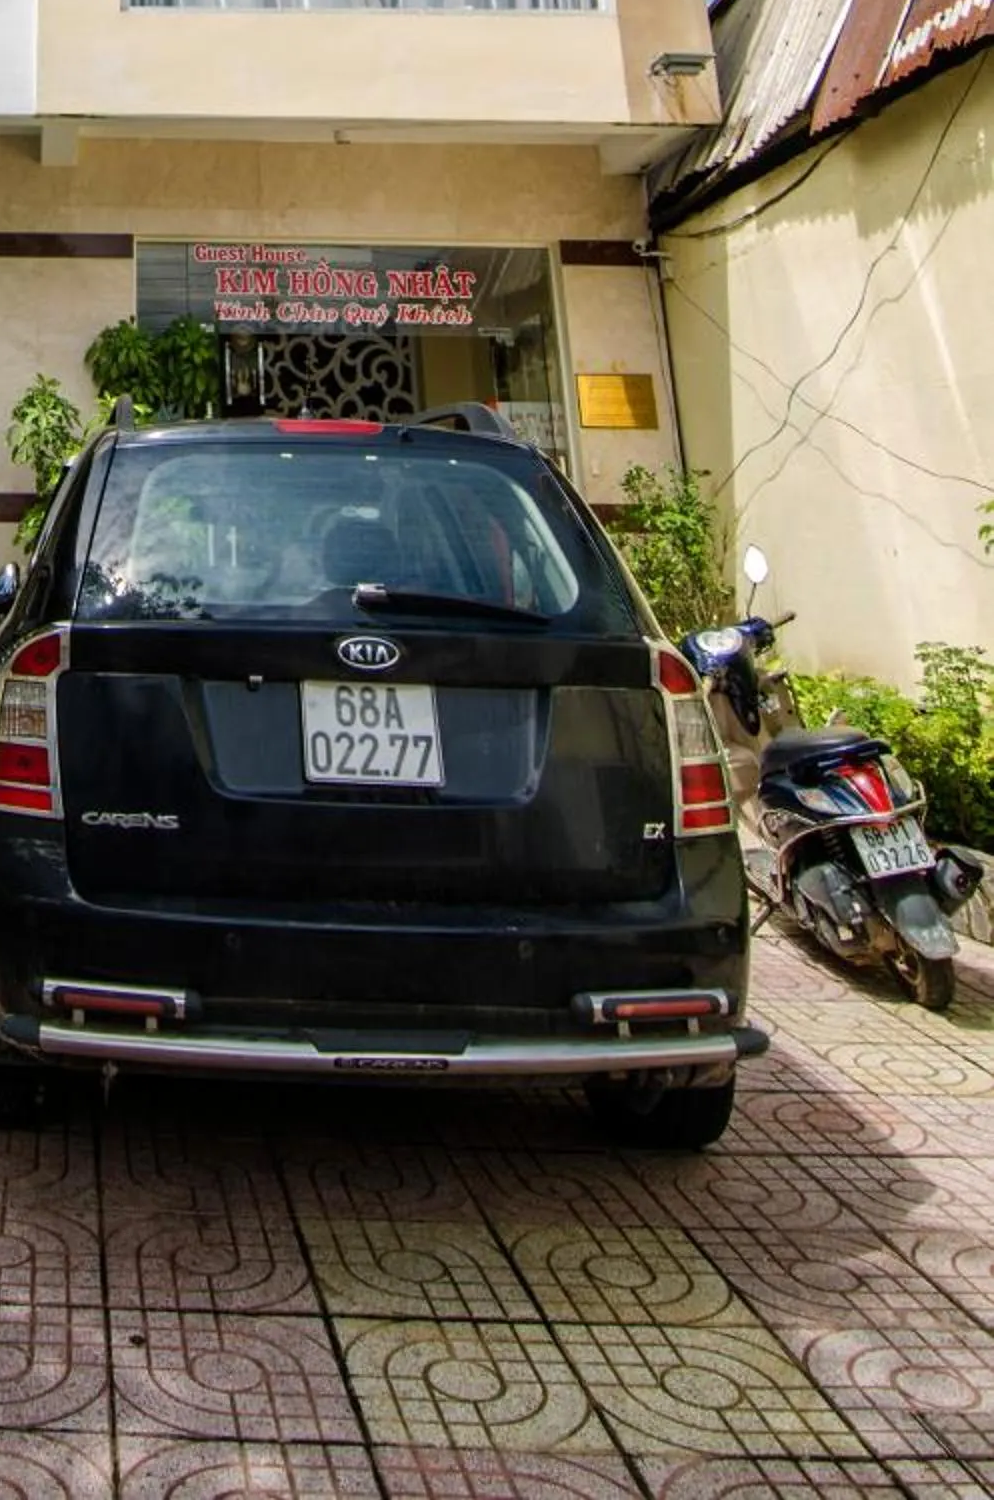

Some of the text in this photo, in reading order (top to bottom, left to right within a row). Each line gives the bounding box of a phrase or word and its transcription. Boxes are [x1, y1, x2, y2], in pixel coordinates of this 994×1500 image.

[194, 244, 307, 262] Guest House
[216, 257, 476, 304] KIM HỒNG NHẬT
[348, 642, 390, 663] KIA
[334, 685, 405, 729] 68A
[311, 731, 433, 778] 022.77
[81, 811, 180, 829] CARENS
[643, 822, 666, 839] EX
